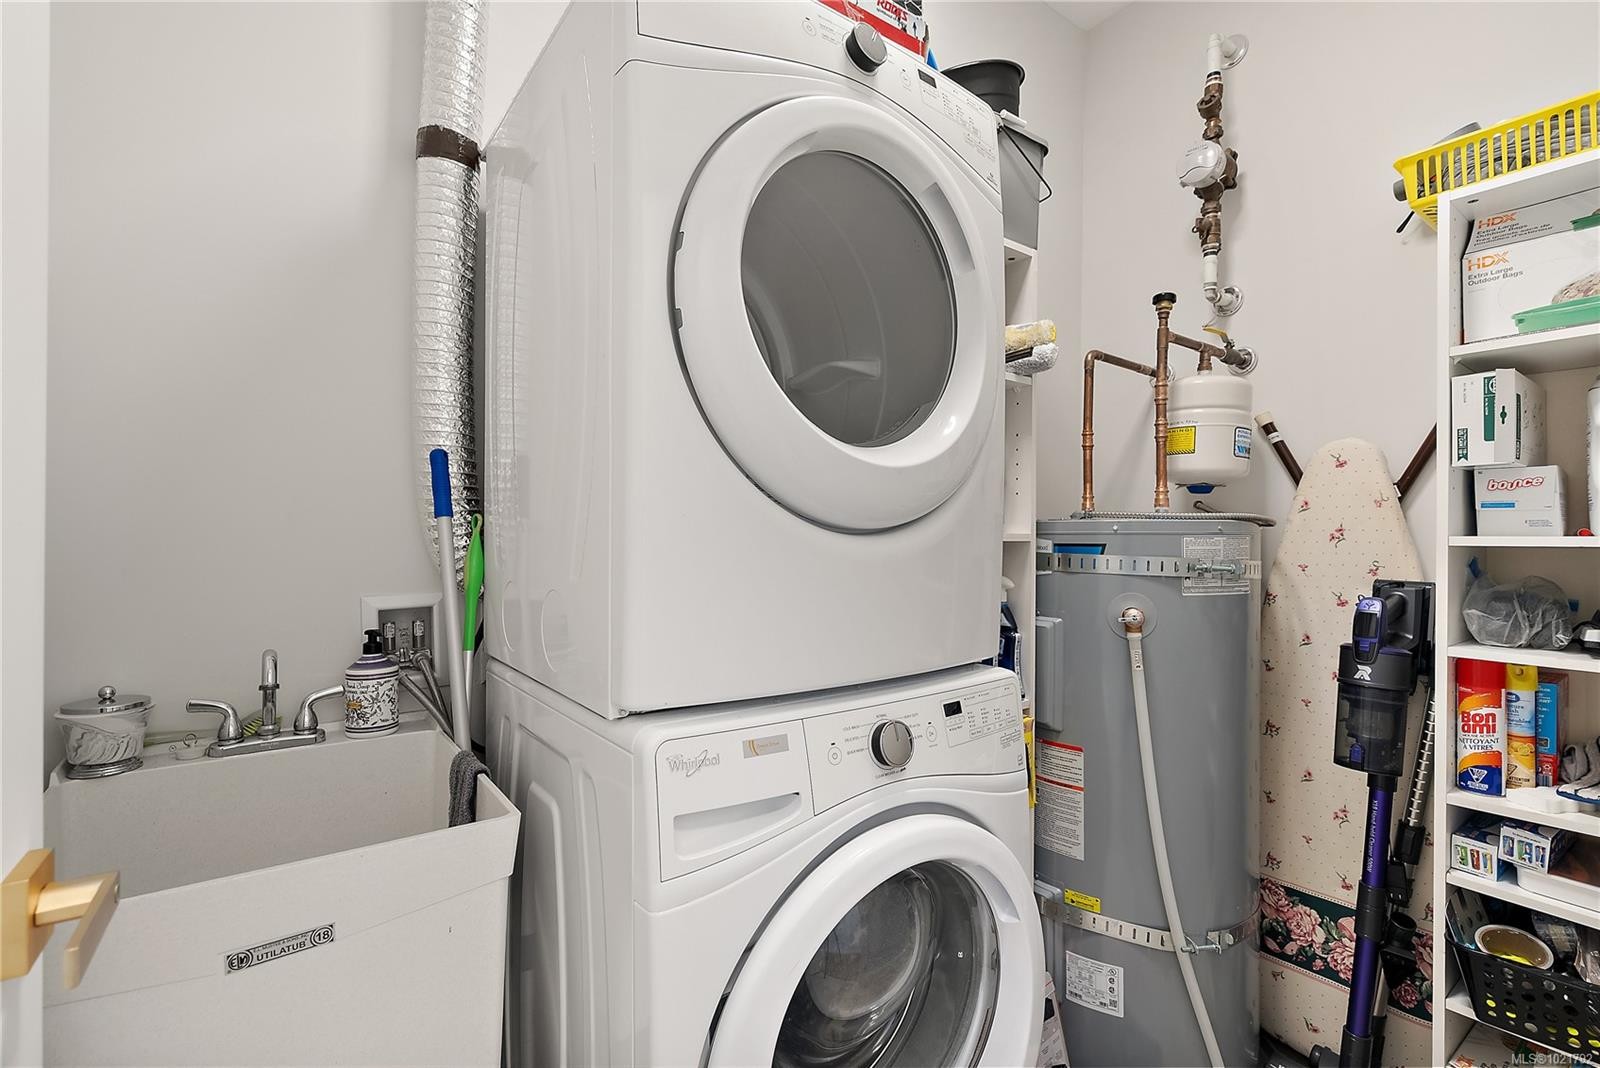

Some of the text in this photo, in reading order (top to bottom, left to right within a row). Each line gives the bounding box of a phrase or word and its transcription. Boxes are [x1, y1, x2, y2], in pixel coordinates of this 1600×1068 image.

[1478, 212, 1518, 229] HDX
[1468, 250, 1510, 271] HDX
[1468, 266, 1514, 280] Extra Large
[1468, 270, 1524, 287] Outdoor Bags
[1487, 476, 1544, 492] bounce
[1461, 711, 1497, 723] Bon
[1461, 723, 1497, 734] ami
[1459, 737, 1500, 745] NETTOYANT
[667, 752, 720, 775] Whirlpool
[315, 930, 330, 941] 18
[256, 941, 306, 961] UTILATUB
